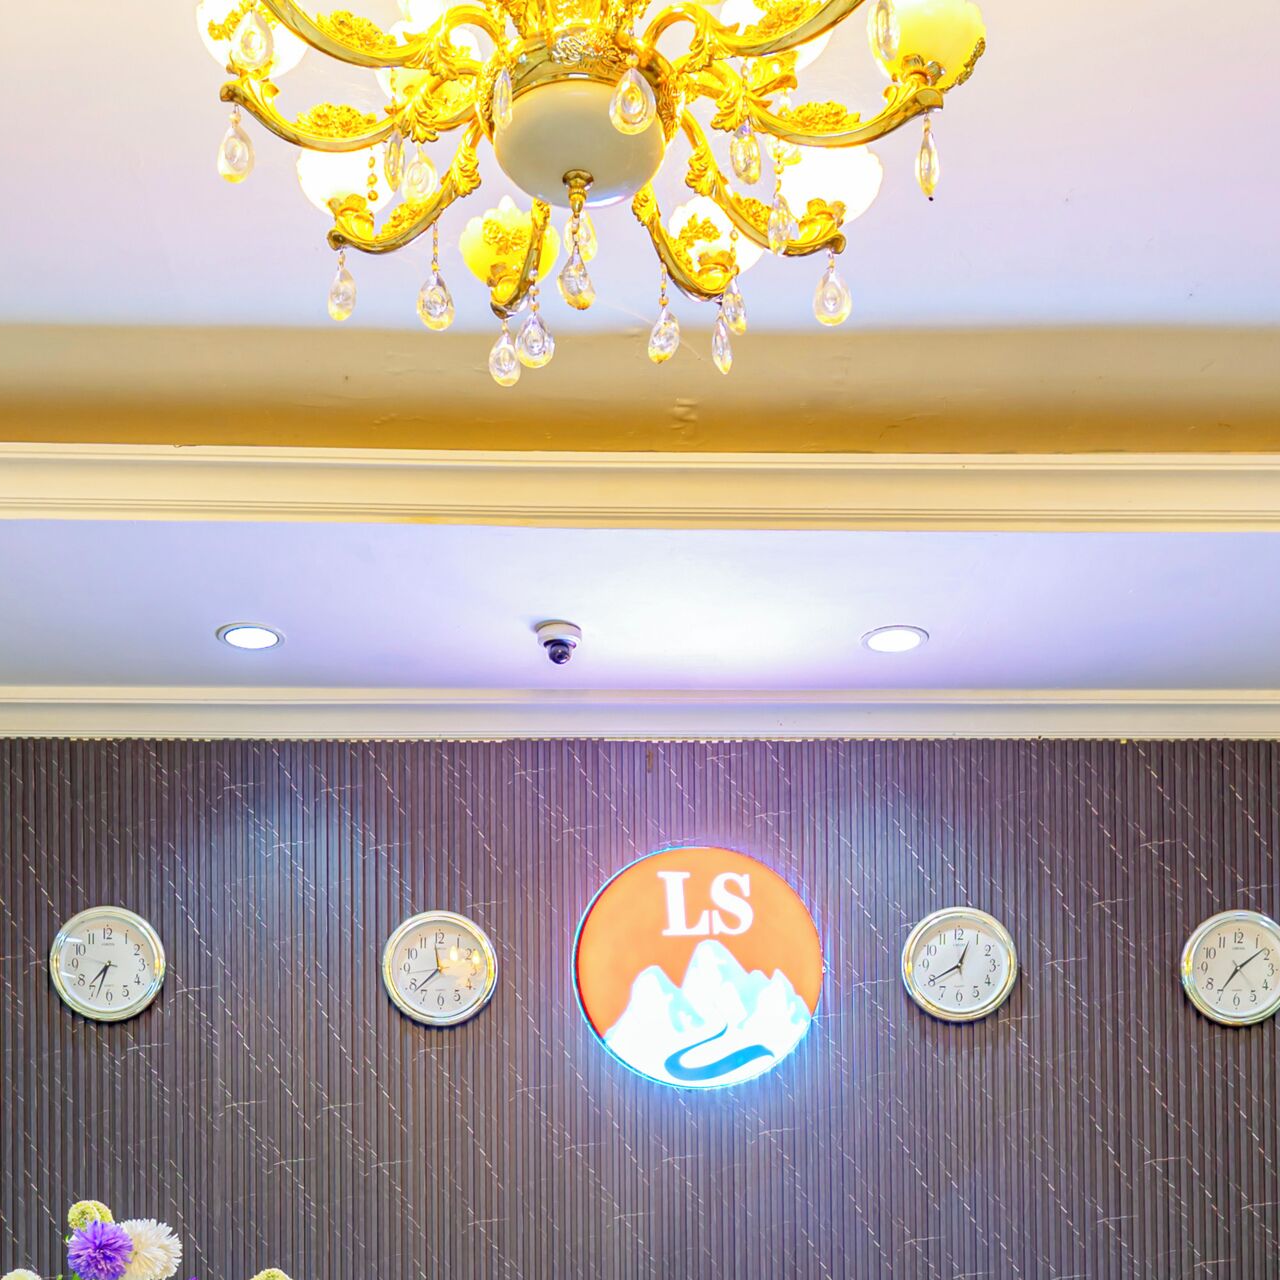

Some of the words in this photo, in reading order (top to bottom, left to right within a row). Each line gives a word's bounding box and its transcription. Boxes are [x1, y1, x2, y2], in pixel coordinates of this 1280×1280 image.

[657, 871, 754, 936] LS
[88, 933, 94, 944] 11
[103, 928, 112, 939] 12
[125, 933, 127, 944] 1
[435, 932, 444, 944] 12
[939, 934, 946, 944] 11
[954, 929, 964, 940] 12
[976, 934, 978, 945] 1
[1234, 932, 1243, 944] 12
[420, 937, 426, 948] 11
[457, 938, 460, 948] 1
[1218, 937, 1225, 948] 11
[1256, 936, 1258, 948] 1
[76, 944, 85, 956] 10
[134, 944, 140, 955] 2
[407, 949, 417, 960] 10
[466, 949, 472, 960] 2
[926, 945, 936, 956] 10
[985, 945, 991, 956] 2
[1206, 947, 1216, 959] 10
[1264, 948, 1270, 960] 2
[72, 959, 78, 970] 9
[139, 959, 145, 971] 3
[404, 964, 410, 974] 9
[922, 959, 929, 970] 9
[990, 960, 996, 972] 3
[1201, 962, 1208, 974] 9
[1268, 964, 1274, 976] 3
[78, 974, 85, 986] 8
[134, 974, 140, 985] 4
[409, 978, 416, 991] 8
[464, 978, 471, 990] 4
[928, 975, 935, 986] 8
[985, 974, 991, 986] 4
[1206, 978, 1213, 990] 8
[1262, 979, 1268, 990] 4
[90, 986, 96, 997] 7
[106, 988, 112, 1001] 6
[122, 985, 129, 997] 5
[421, 990, 427, 1002] 7
[454, 990, 460, 1001] 5
[939, 986, 946, 998] 7
[956, 990, 962, 1002] 6
[973, 986, 979, 998] 5
[1217, 989, 1223, 1001] 7
[1250, 990, 1256, 1002] 5
[438, 994, 444, 1006] 6
[1233, 993, 1240, 1005] 6
